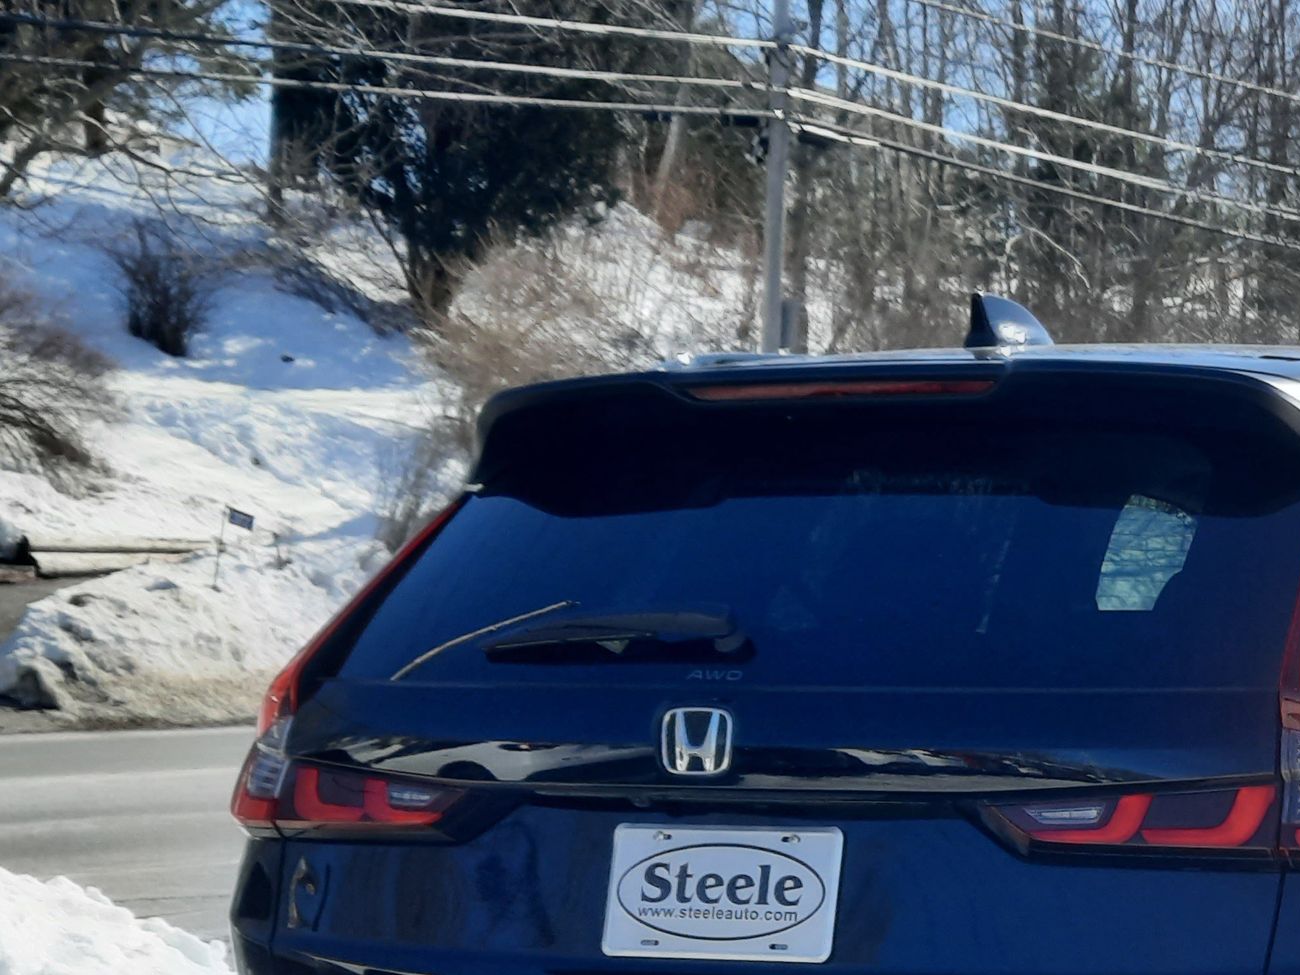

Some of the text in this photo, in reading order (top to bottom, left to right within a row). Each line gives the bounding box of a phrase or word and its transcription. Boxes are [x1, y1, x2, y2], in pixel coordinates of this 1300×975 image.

[686, 669, 744, 681] AWD
[640, 861, 803, 907] Steele
[637, 904, 799, 922] www.steeleauto.com
